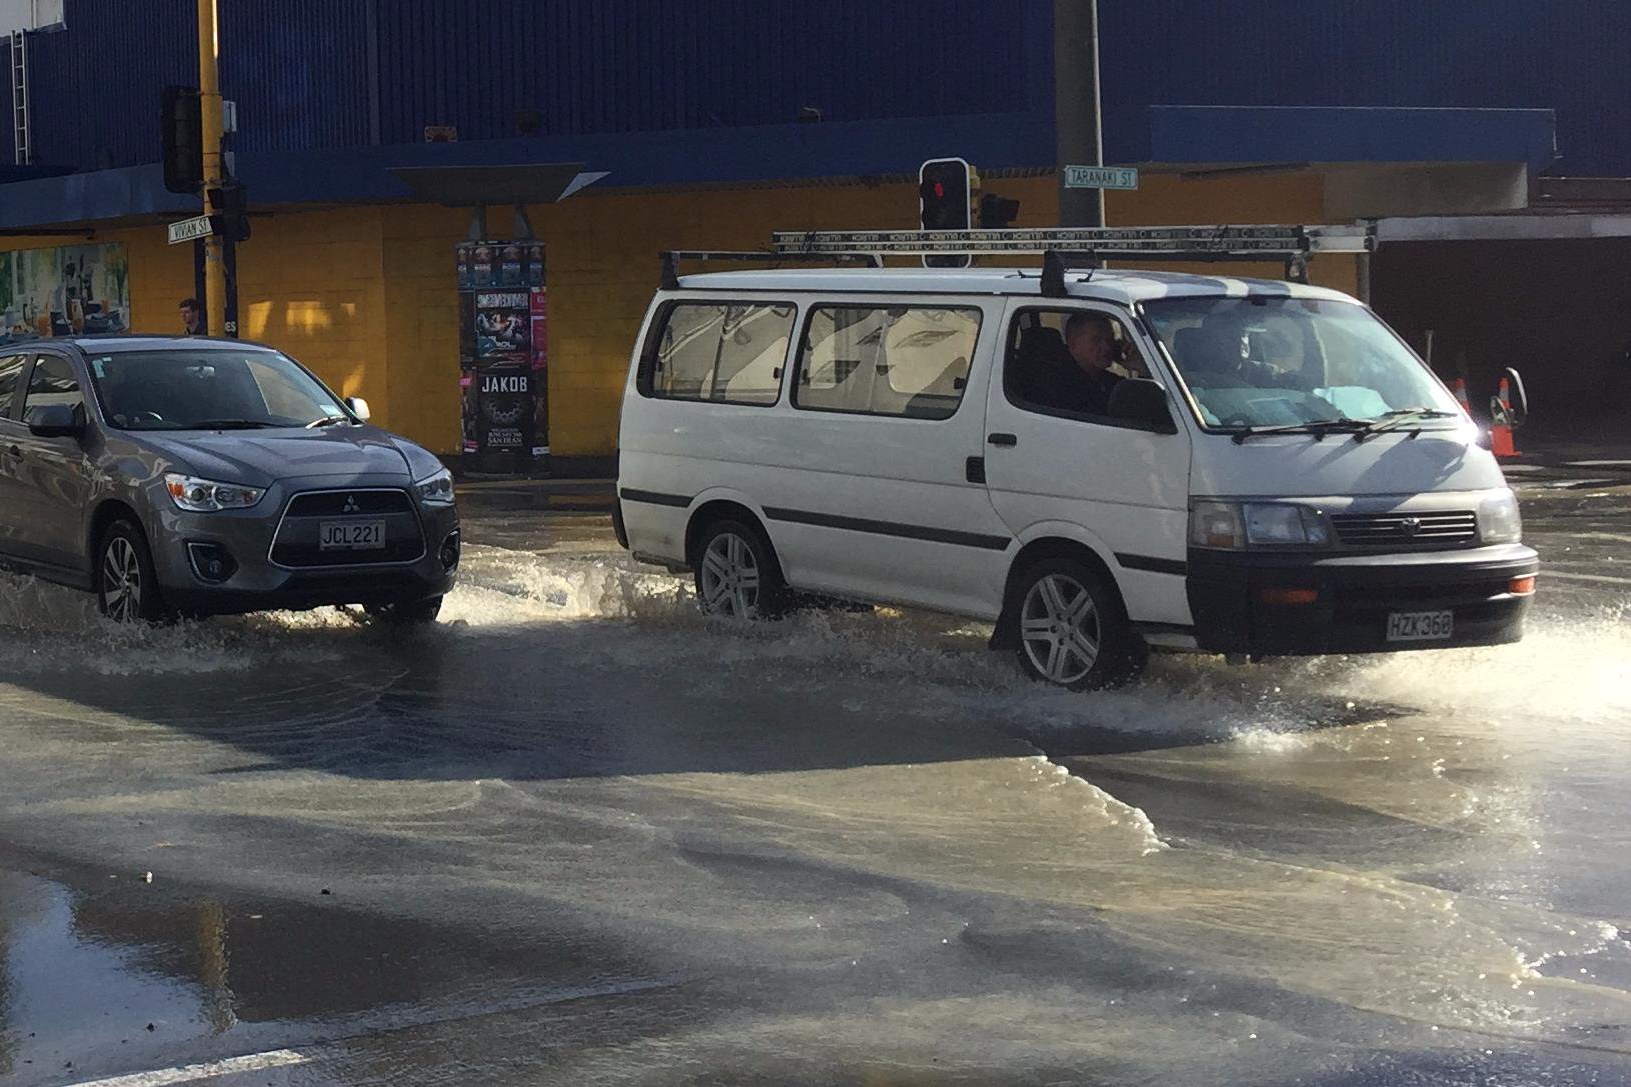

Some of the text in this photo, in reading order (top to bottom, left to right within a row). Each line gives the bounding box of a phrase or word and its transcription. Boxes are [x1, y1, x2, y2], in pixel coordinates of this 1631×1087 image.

[1071, 169, 1132, 185] TARANAKI ST
[173, 218, 209, 238] VIVIAN ST
[481, 376, 528, 393] JAKOB
[323, 525, 380, 545] JCL221
